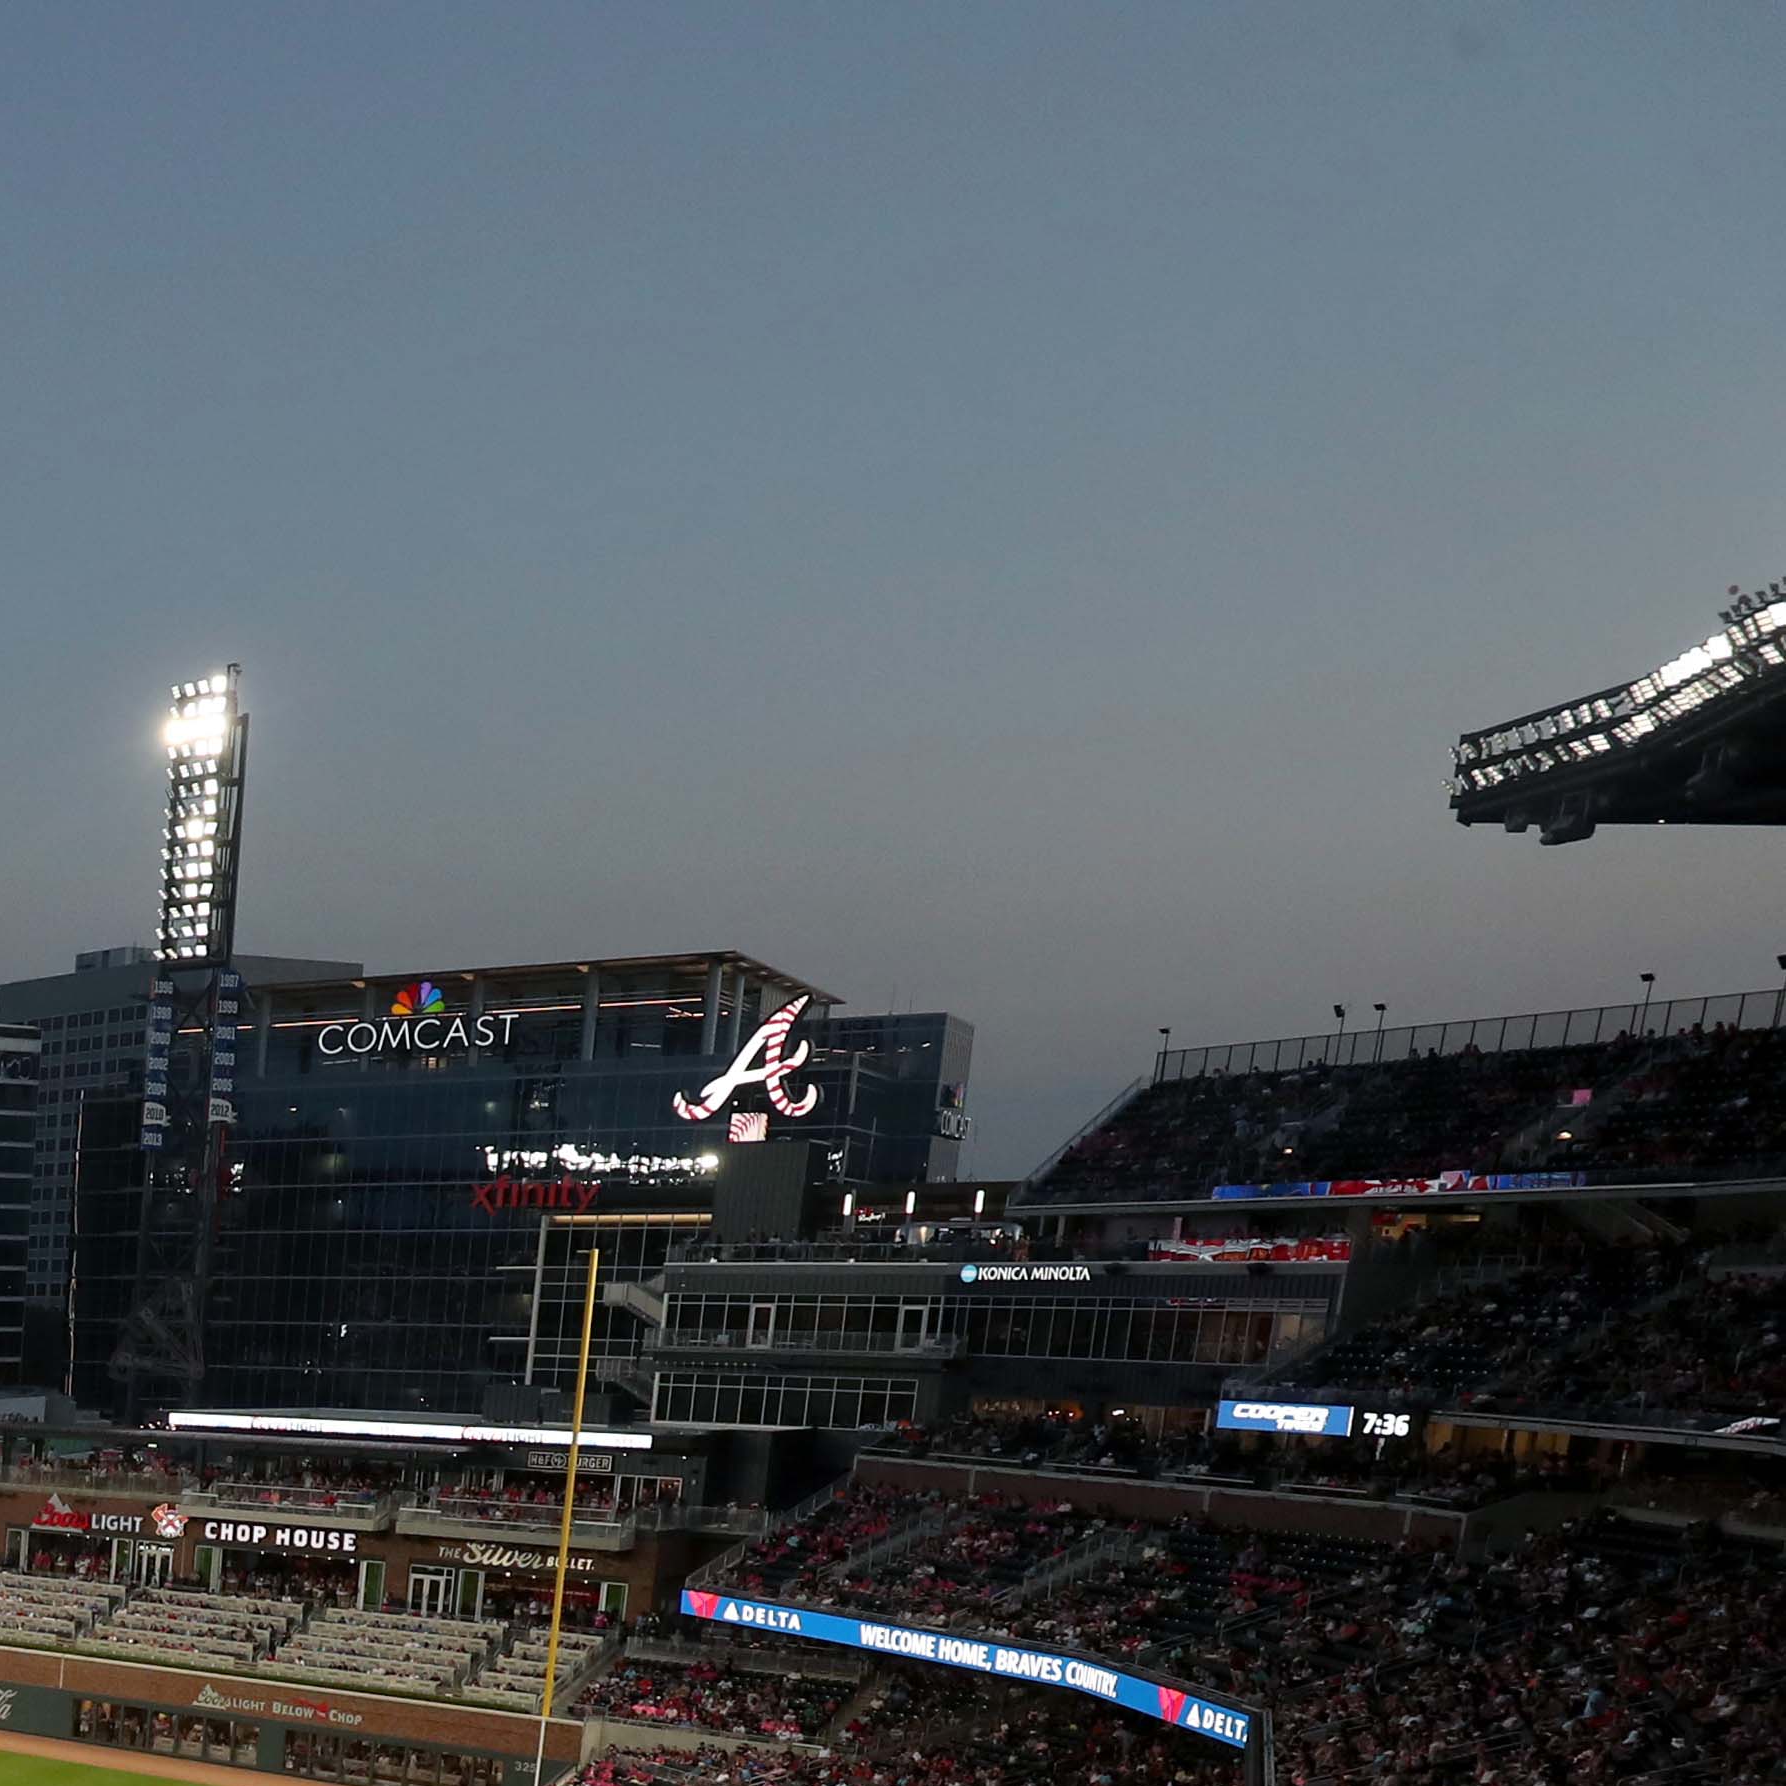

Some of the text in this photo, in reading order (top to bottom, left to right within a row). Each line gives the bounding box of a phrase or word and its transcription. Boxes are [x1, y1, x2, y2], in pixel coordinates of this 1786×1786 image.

[317, 1014, 520, 1057] COMCAST
[145, 1107, 164, 1120] 2010
[210, 1104, 230, 1116] 2012
[143, 1132, 162, 1146] 2013
[471, 1174, 602, 1215] xfinity
[977, 1265, 1091, 1282] KONICA MINOLTA
[1233, 1403, 1329, 1422] COOPER
[1363, 1412, 1410, 1436] 7:36
[568, 1456, 609, 1469] URGER
[33, 1503, 143, 1533] Coors LIGHT
[205, 1522, 357, 1551] CHOP HOUSE
[438, 1542, 594, 1571] THE Silver BULET.
[741, 1607, 801, 1631] DELTA
[860, 1623, 1118, 1698] WELCOME HOME, BRAVES COUNTRY.
[233, 1698, 265, 1712] LIGHT
[273, 1702, 314, 1719] BELOW
[329, 1709, 363, 1726] CHOP
